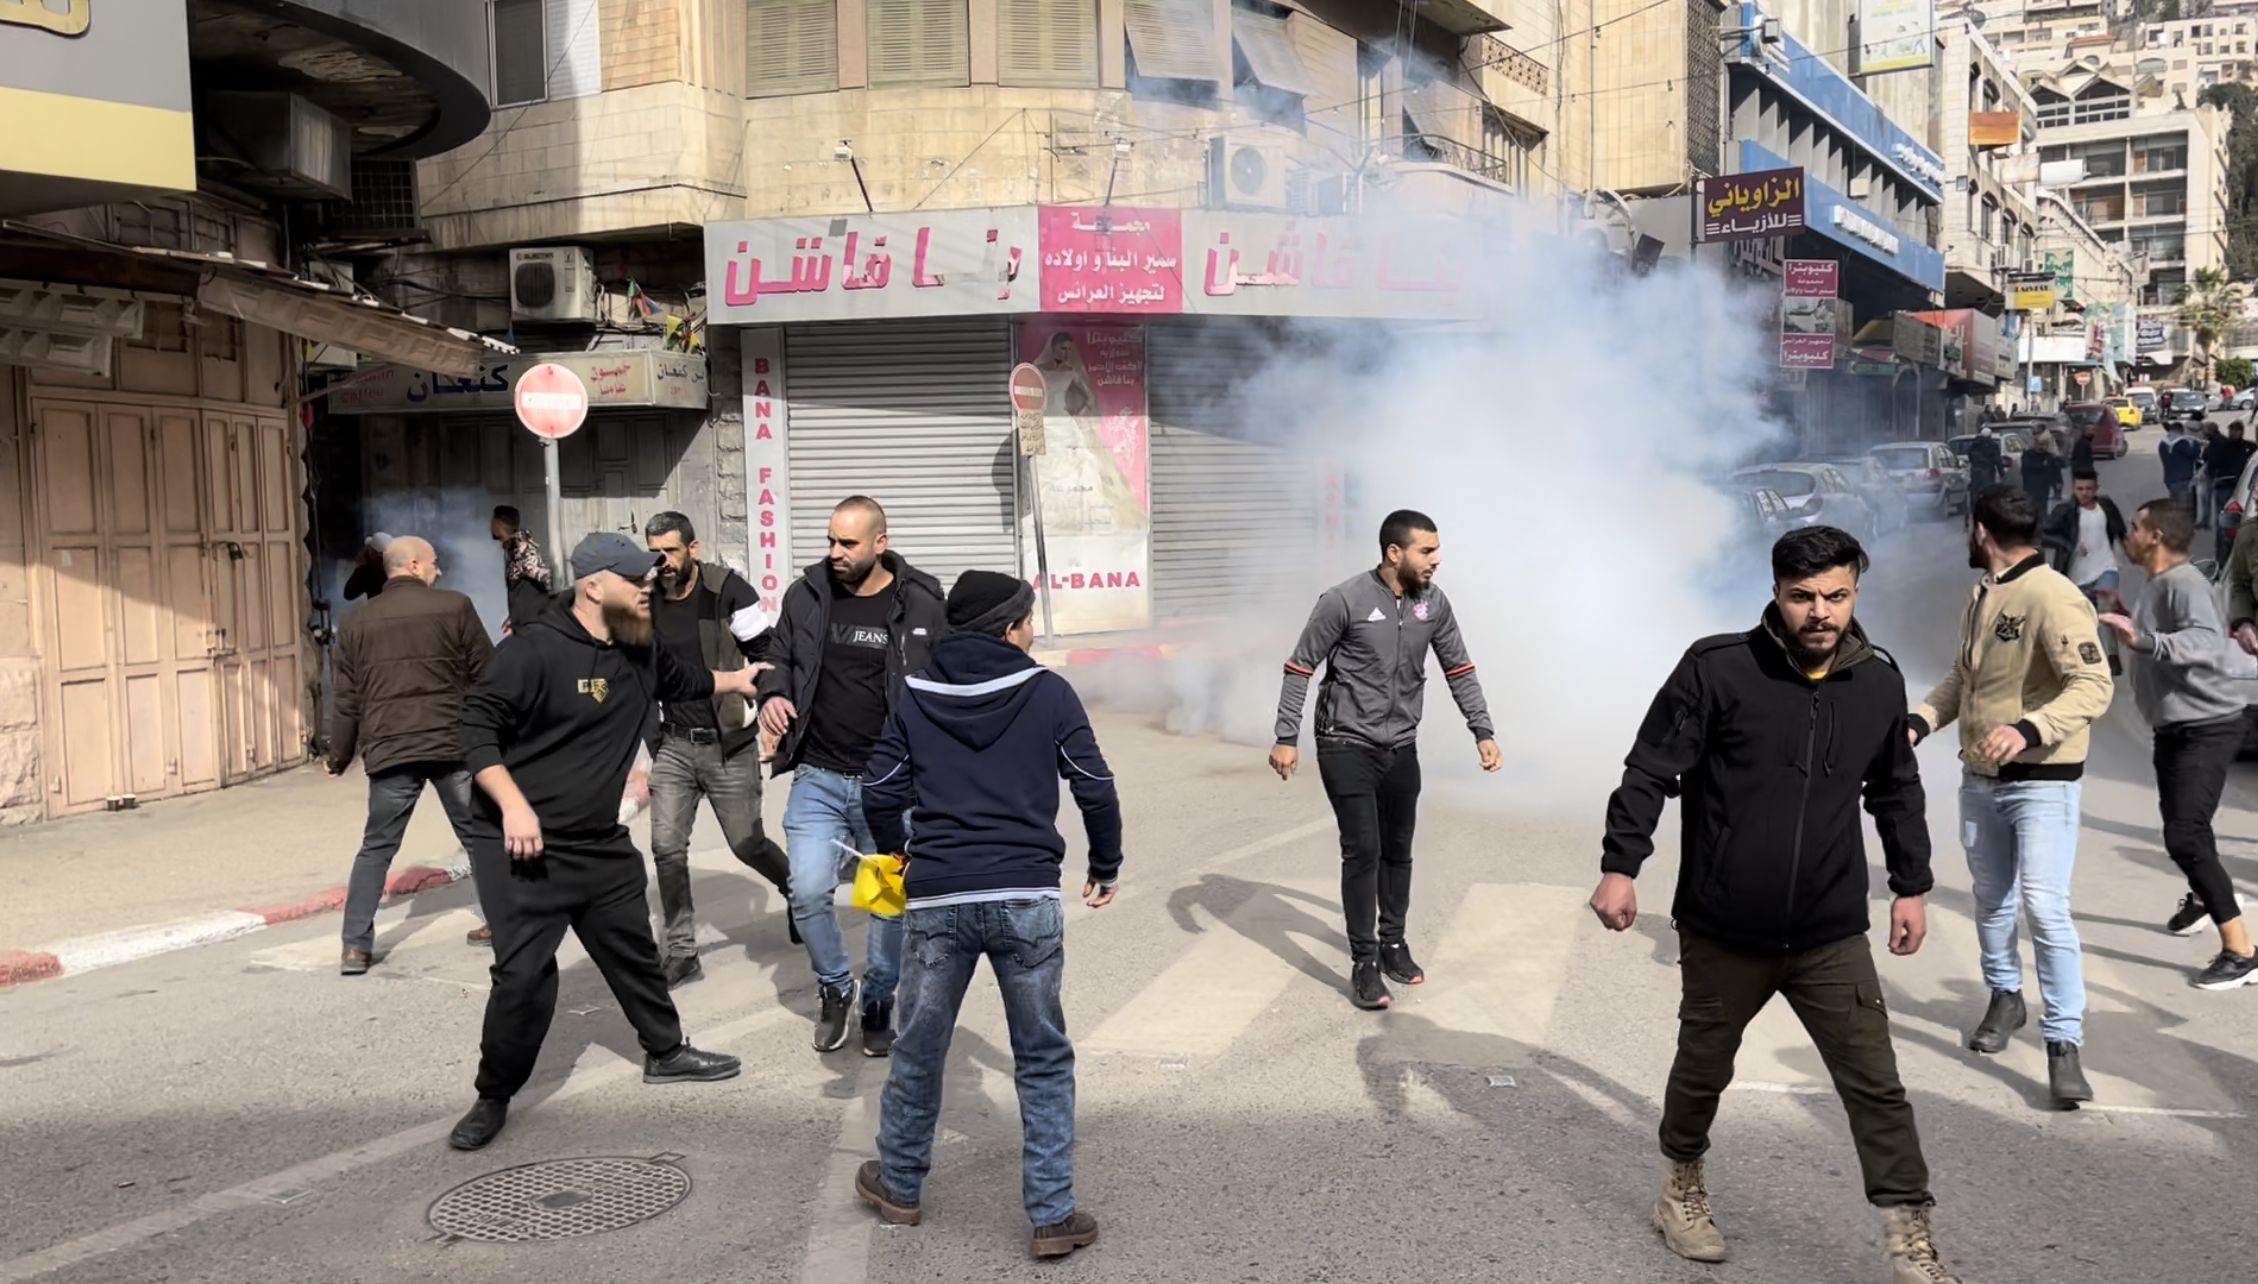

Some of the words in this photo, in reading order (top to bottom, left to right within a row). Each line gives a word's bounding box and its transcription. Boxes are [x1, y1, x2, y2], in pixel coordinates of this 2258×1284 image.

[1708, 176, 1801, 217] الزاوياني
[1721, 212, 1788, 234] للأزياء
[724, 230, 893, 308] فاشن
[1106, 247, 1139, 273] البنا
[1142, 253, 1177, 275] سمير
[754, 357, 773, 441] BANA
[757, 467, 779, 613] FASHION
[852, 629, 889, 645] JEANS
